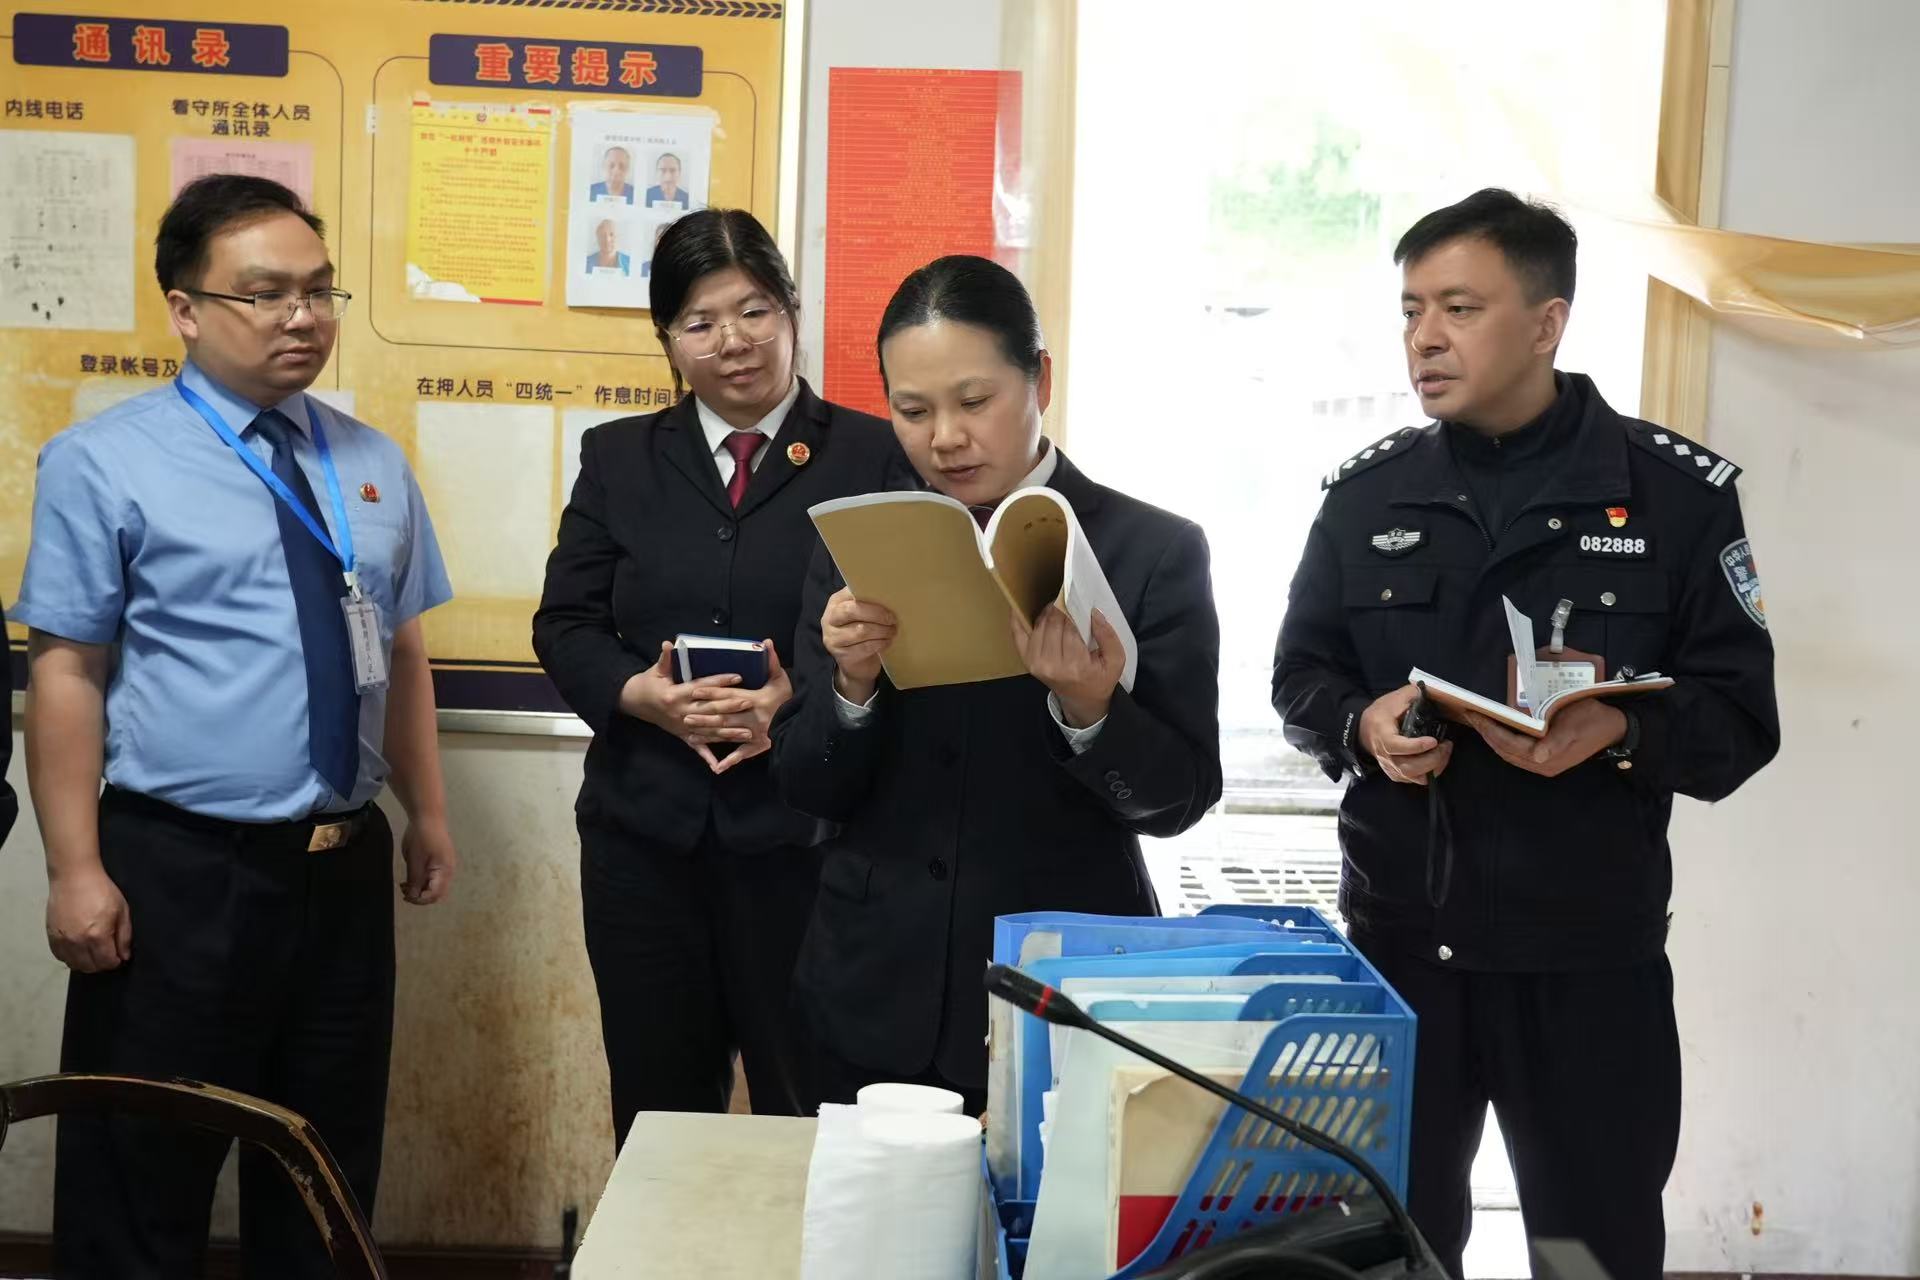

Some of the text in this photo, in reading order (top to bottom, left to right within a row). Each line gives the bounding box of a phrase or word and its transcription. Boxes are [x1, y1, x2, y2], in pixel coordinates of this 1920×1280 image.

[73, 24, 230, 67] 通讯录
[475, 43, 657, 88] 重要提示
[5, 99, 84, 121] 内线电话
[172, 99, 311, 121] 看守所全体人员
[211, 120, 271, 138] 通讯录
[80, 354, 184, 378] 登录帐号及
[1580, 535, 1646, 554] 082888
[1343, 712, 1354, 747] POLICE
